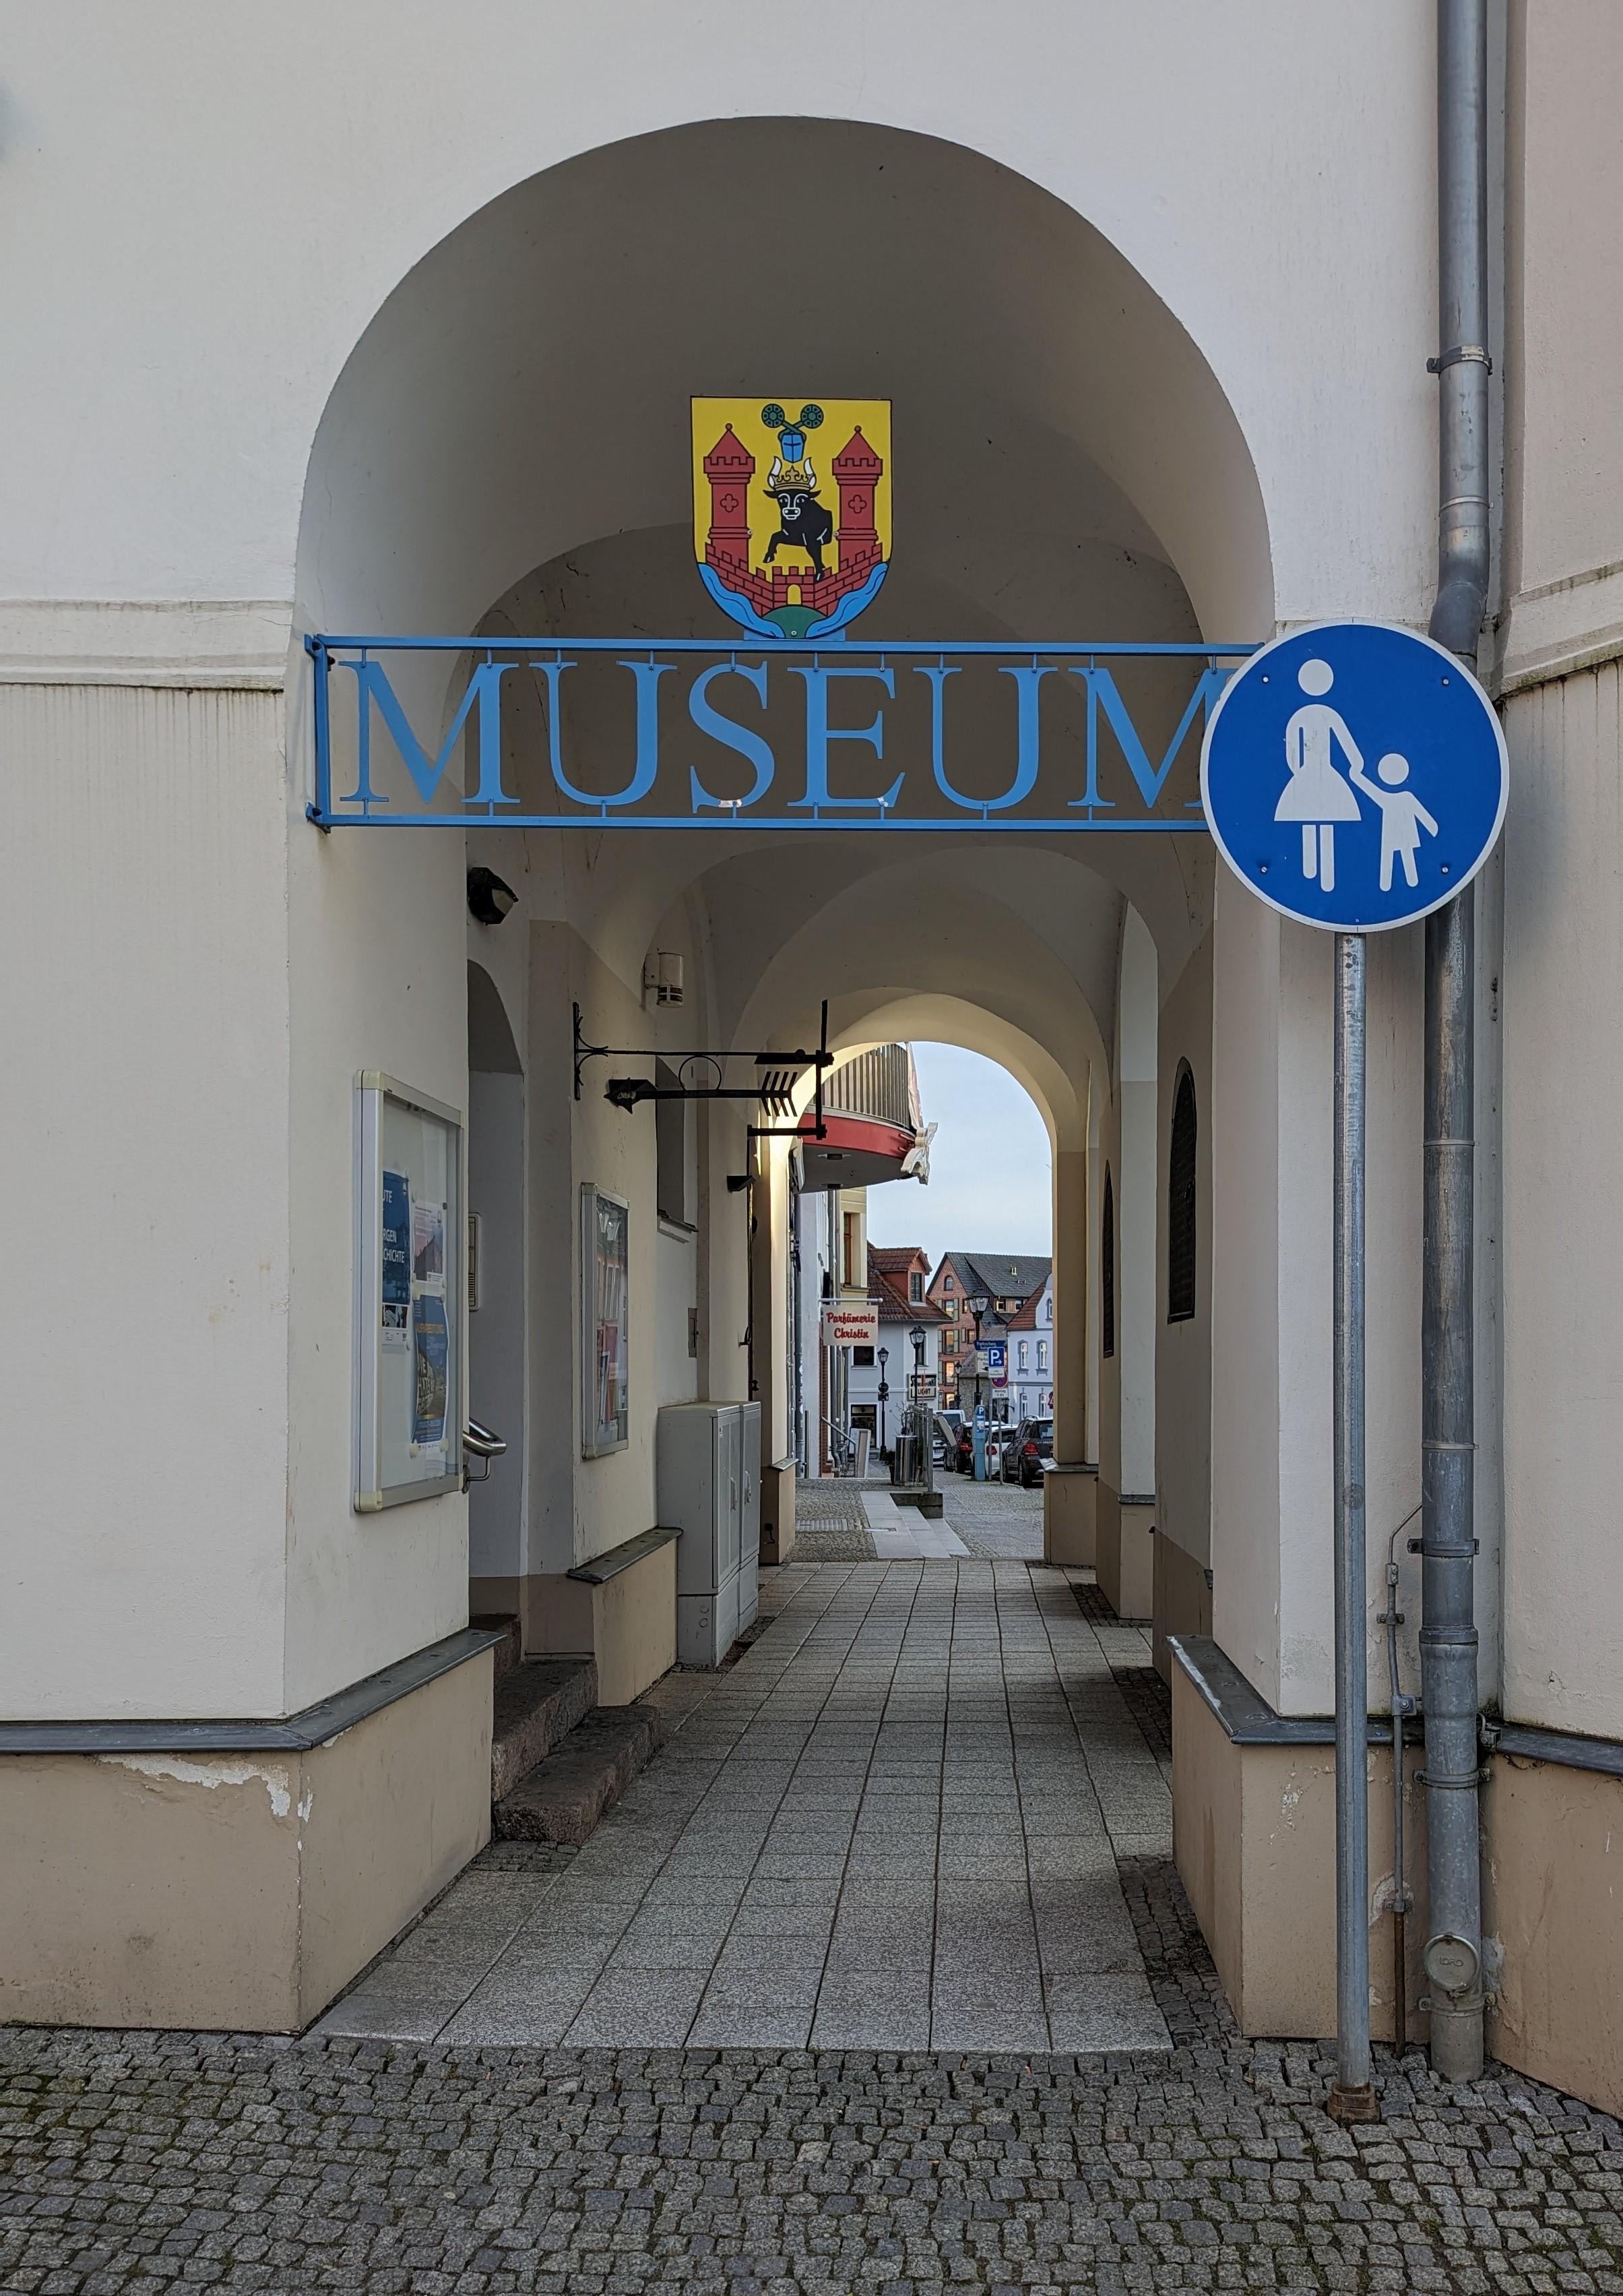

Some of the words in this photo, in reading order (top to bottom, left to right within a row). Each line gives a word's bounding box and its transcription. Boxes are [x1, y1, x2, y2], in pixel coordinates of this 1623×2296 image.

[339, 660, 1238, 813] MUSEUM
[826, 1312, 876, 1325] Parfümerie
[834, 1327, 869, 1338] Christin
[990, 1349, 1000, 1365] P
[979, 1406, 984, 1415] P
